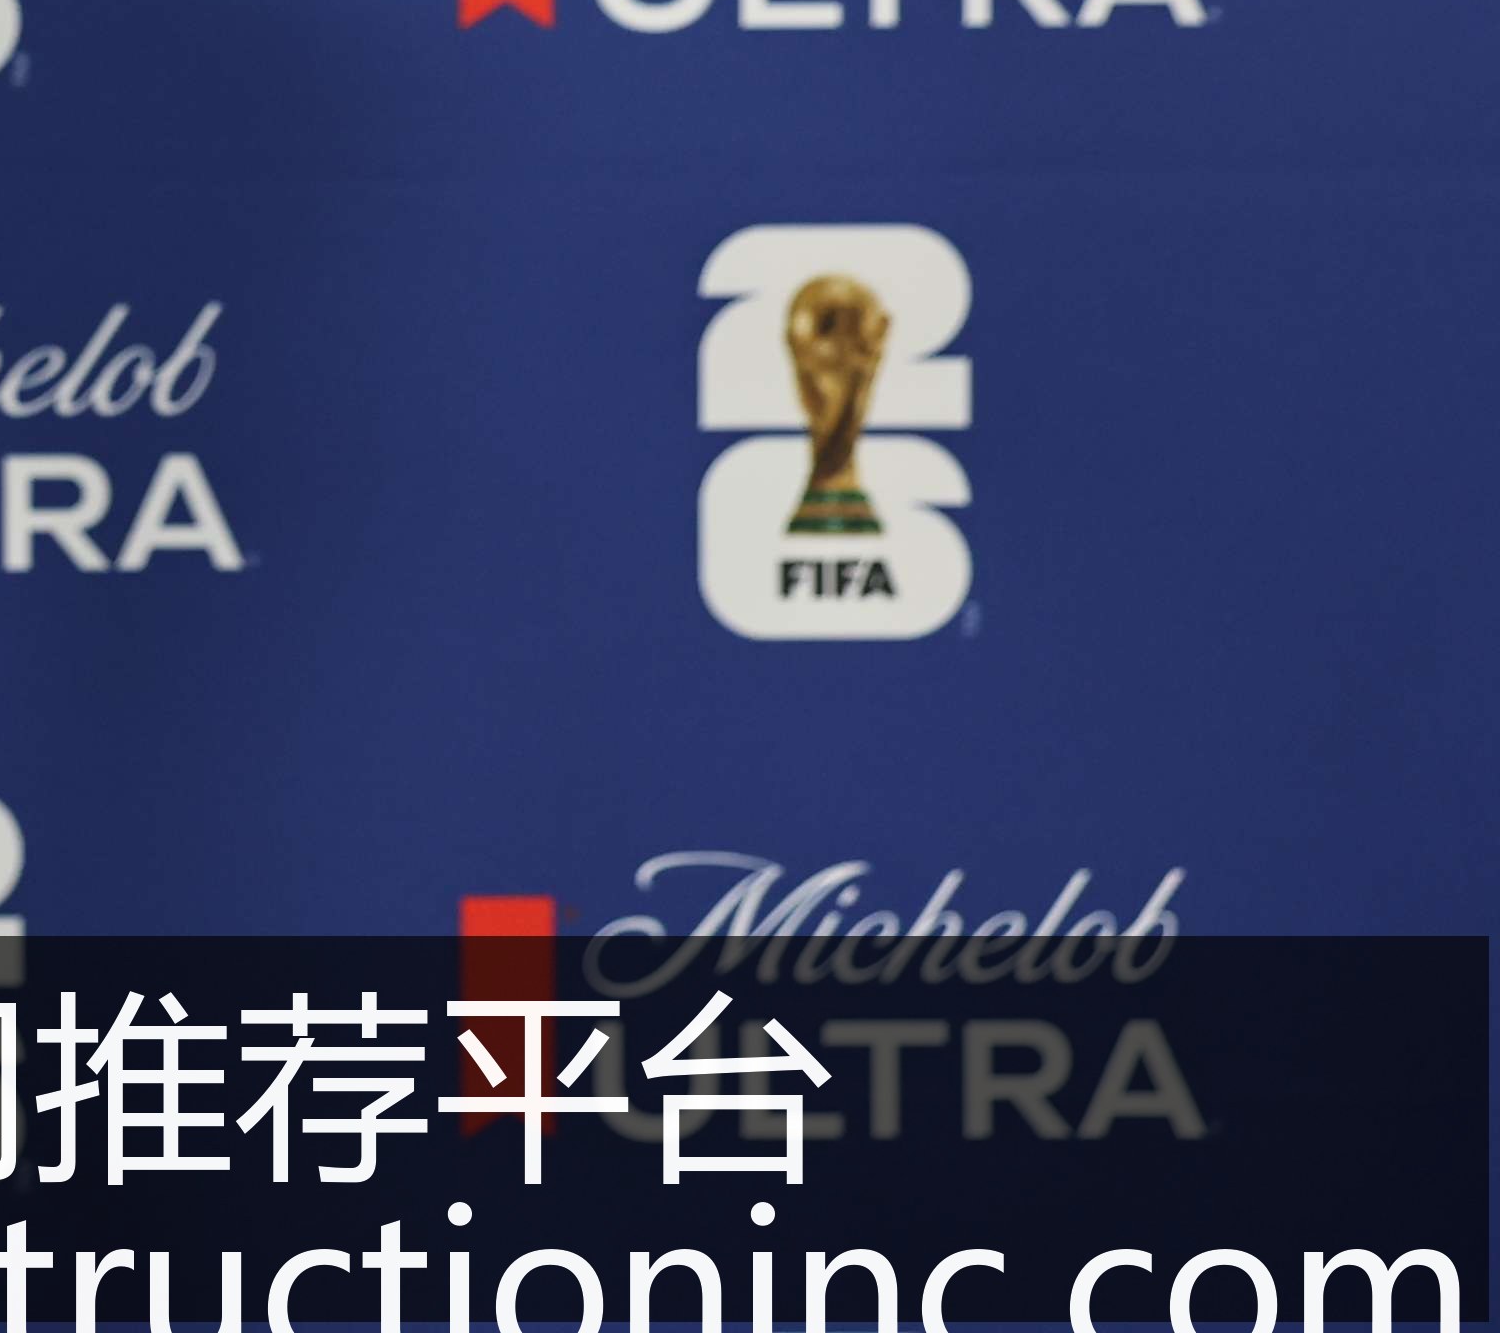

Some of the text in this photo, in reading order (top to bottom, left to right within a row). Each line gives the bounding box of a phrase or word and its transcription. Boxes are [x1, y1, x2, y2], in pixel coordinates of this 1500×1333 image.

[778, 558, 897, 600] FIFA
[582, 849, 1188, 999] Michelob
[590, 1018, 1209, 1143] ULTRA
